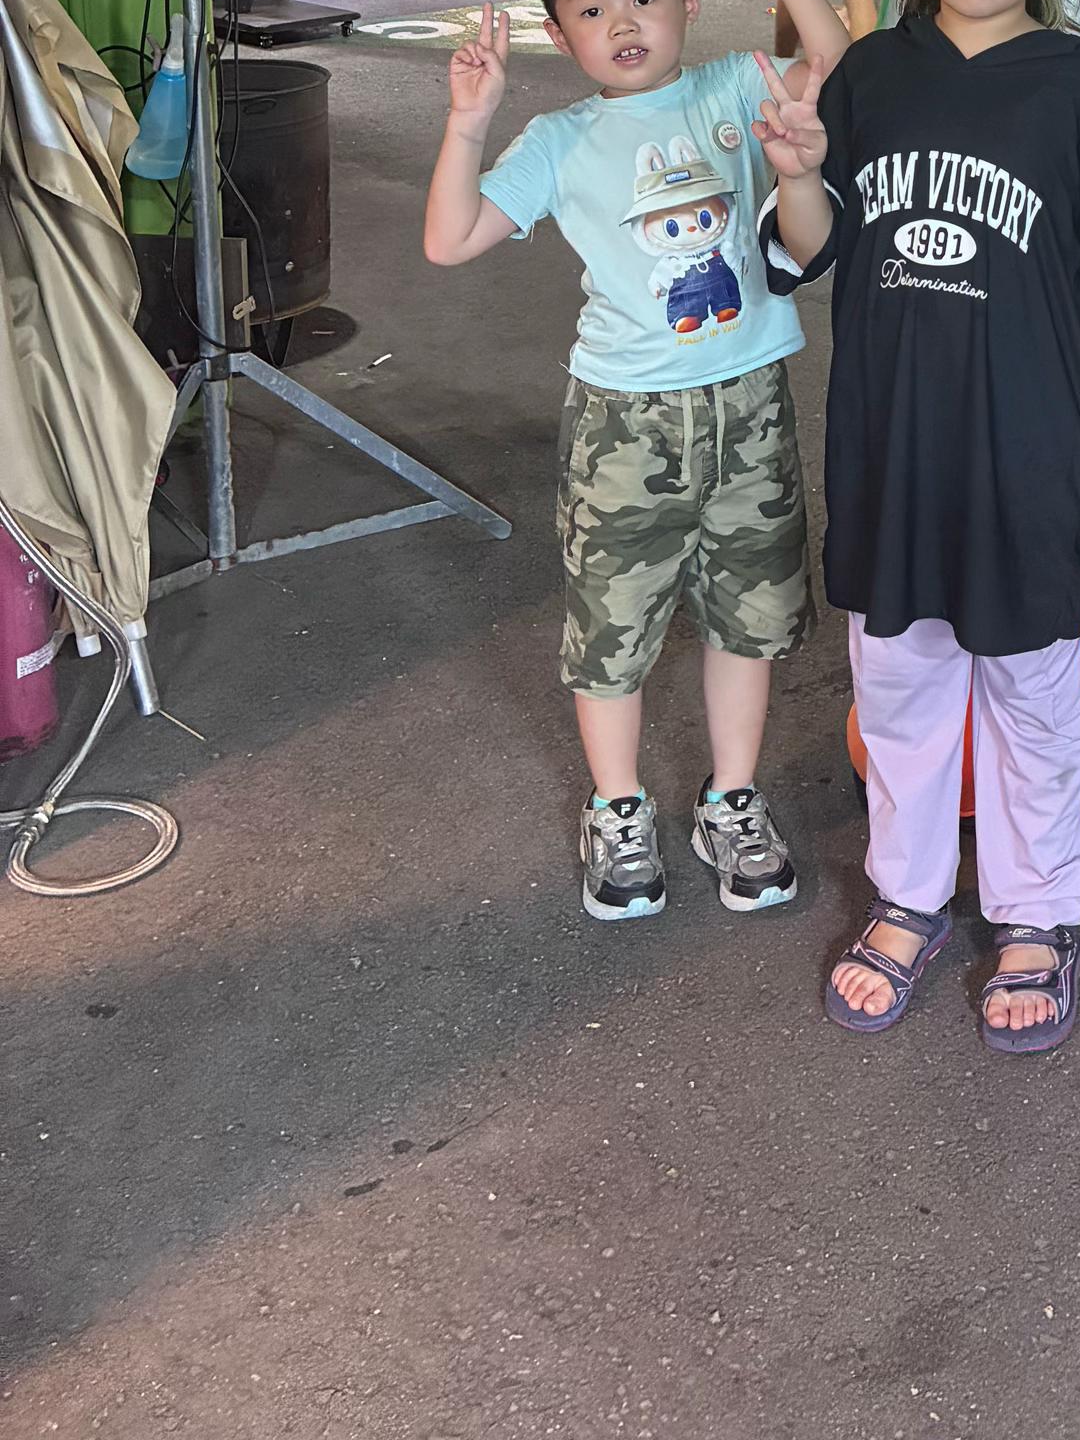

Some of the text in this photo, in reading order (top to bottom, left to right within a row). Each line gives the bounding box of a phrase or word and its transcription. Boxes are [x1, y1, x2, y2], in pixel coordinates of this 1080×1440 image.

[855, 150, 1043, 254] TEAM VICTORY
[906, 223, 963, 260] 1991
[880, 259, 988, 300] Determination
